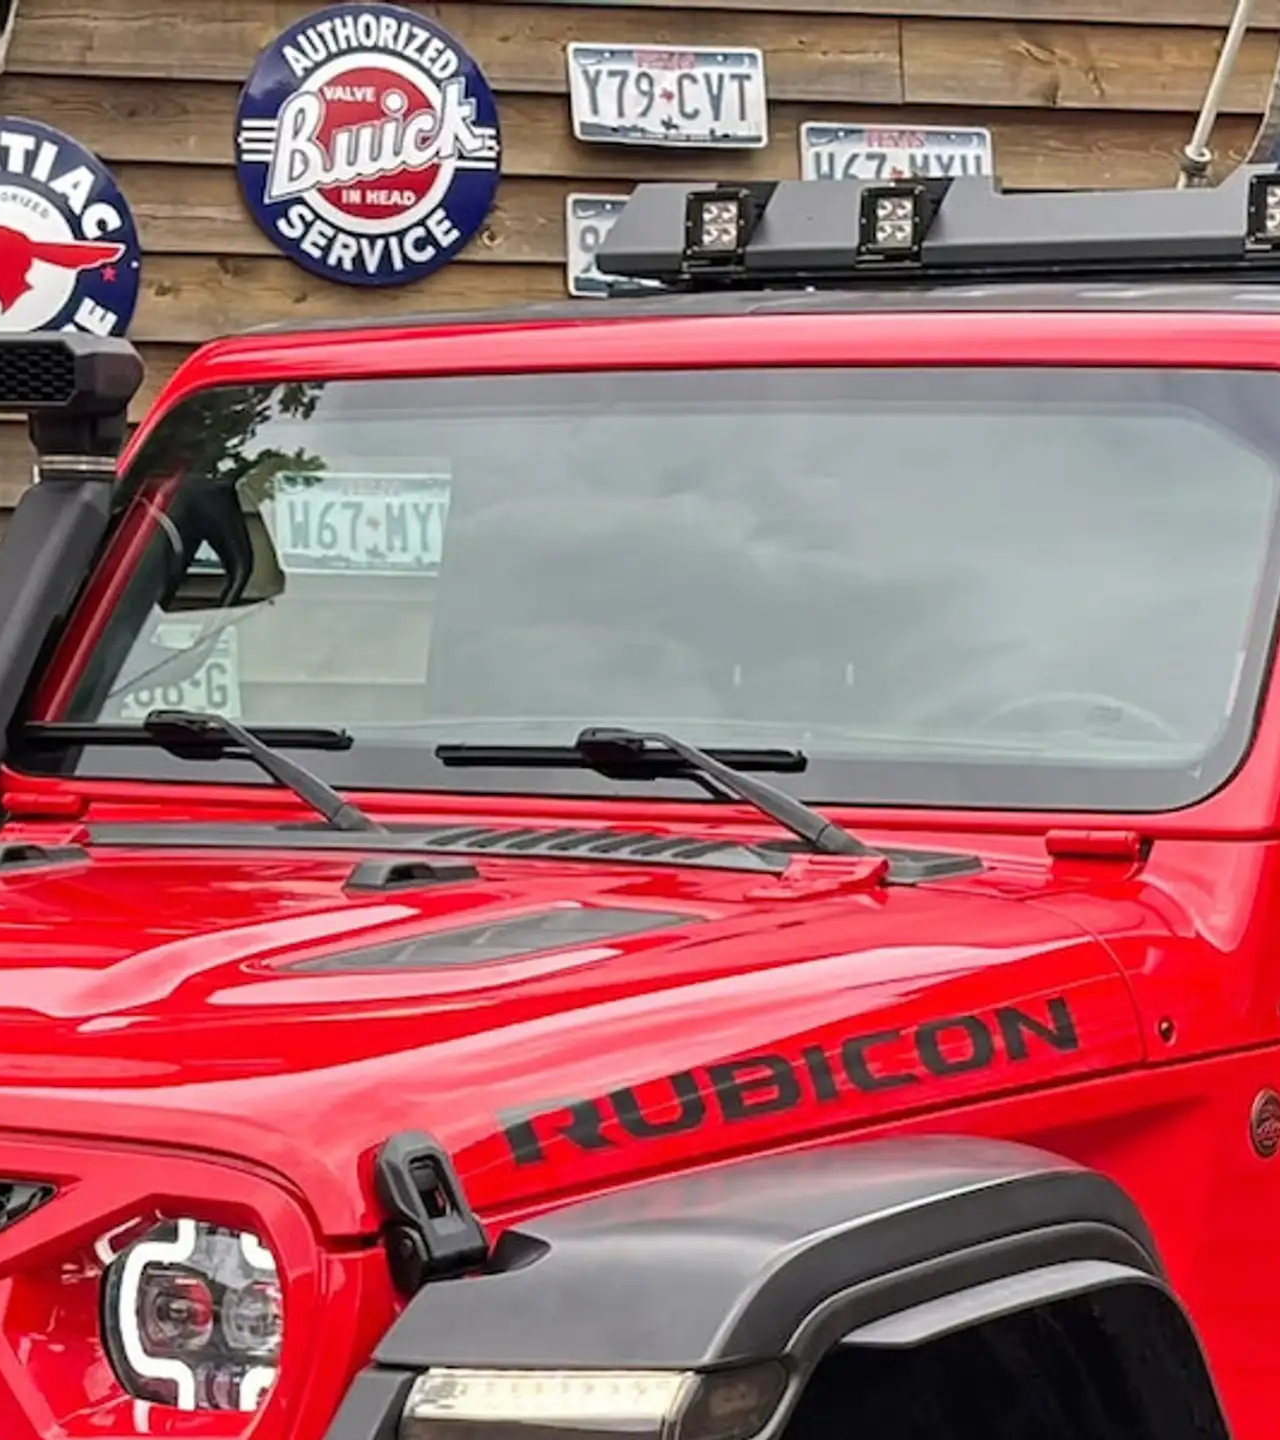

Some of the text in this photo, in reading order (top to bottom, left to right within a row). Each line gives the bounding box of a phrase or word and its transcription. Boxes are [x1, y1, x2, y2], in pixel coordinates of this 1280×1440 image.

[282, 13, 459, 79] AUTHORIZED
[323, 86, 376, 102] VALVE
[264, 77, 484, 204] Buick
[341, 189, 416, 206] IN HEAD
[276, 204, 461, 274] SERVICE
[494, 995, 1080, 1167] RUBICON
